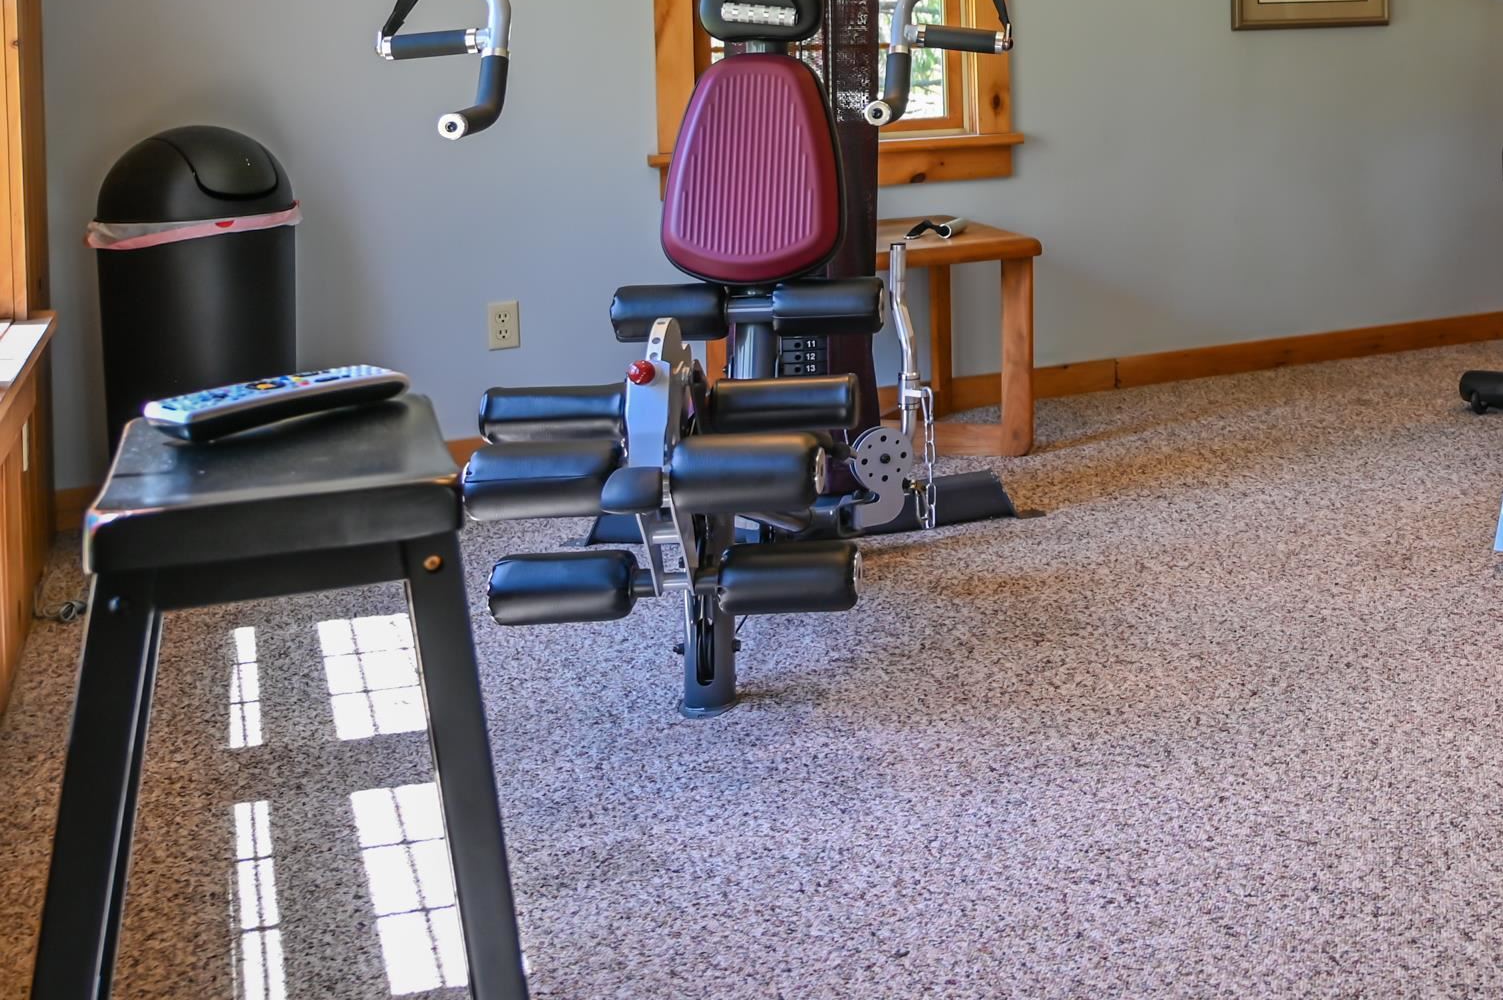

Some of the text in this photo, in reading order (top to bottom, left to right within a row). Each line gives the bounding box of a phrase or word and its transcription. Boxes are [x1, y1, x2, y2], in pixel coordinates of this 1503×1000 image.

[807, 340, 816, 348] 11
[806, 352, 816, 361] 12
[806, 364, 816, 372] 13
